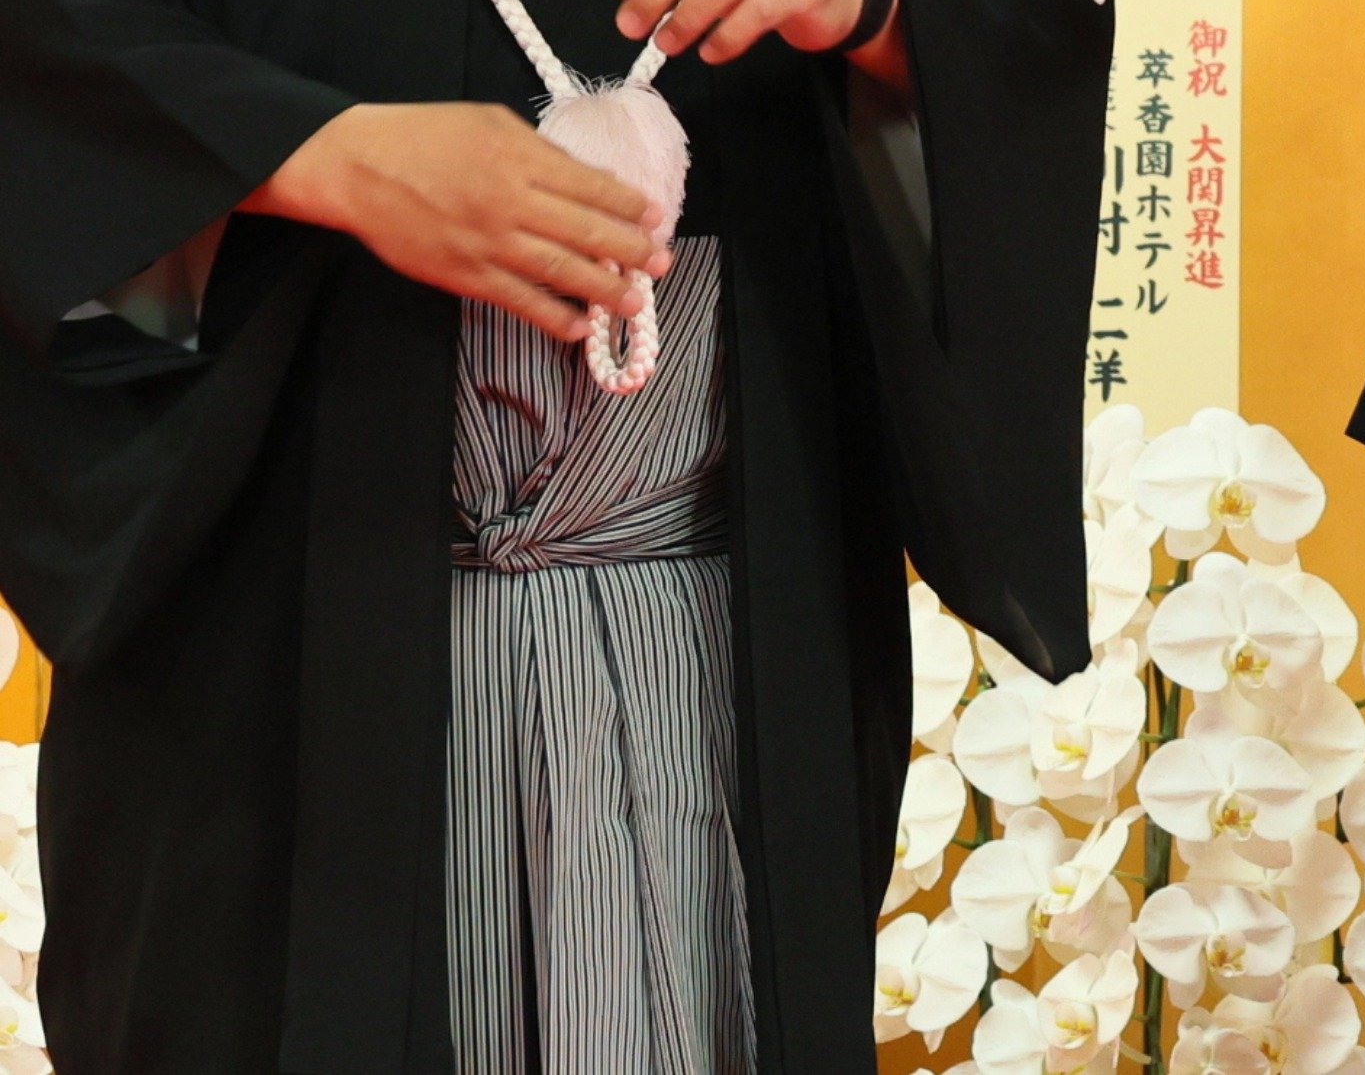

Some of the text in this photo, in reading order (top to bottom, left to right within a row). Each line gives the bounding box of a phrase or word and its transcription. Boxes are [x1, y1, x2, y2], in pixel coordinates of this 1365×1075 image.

[1134, 48, 1174, 315] 萃香園ホテル
[1184, 19, 1228, 290] 御祝 大関昇進
